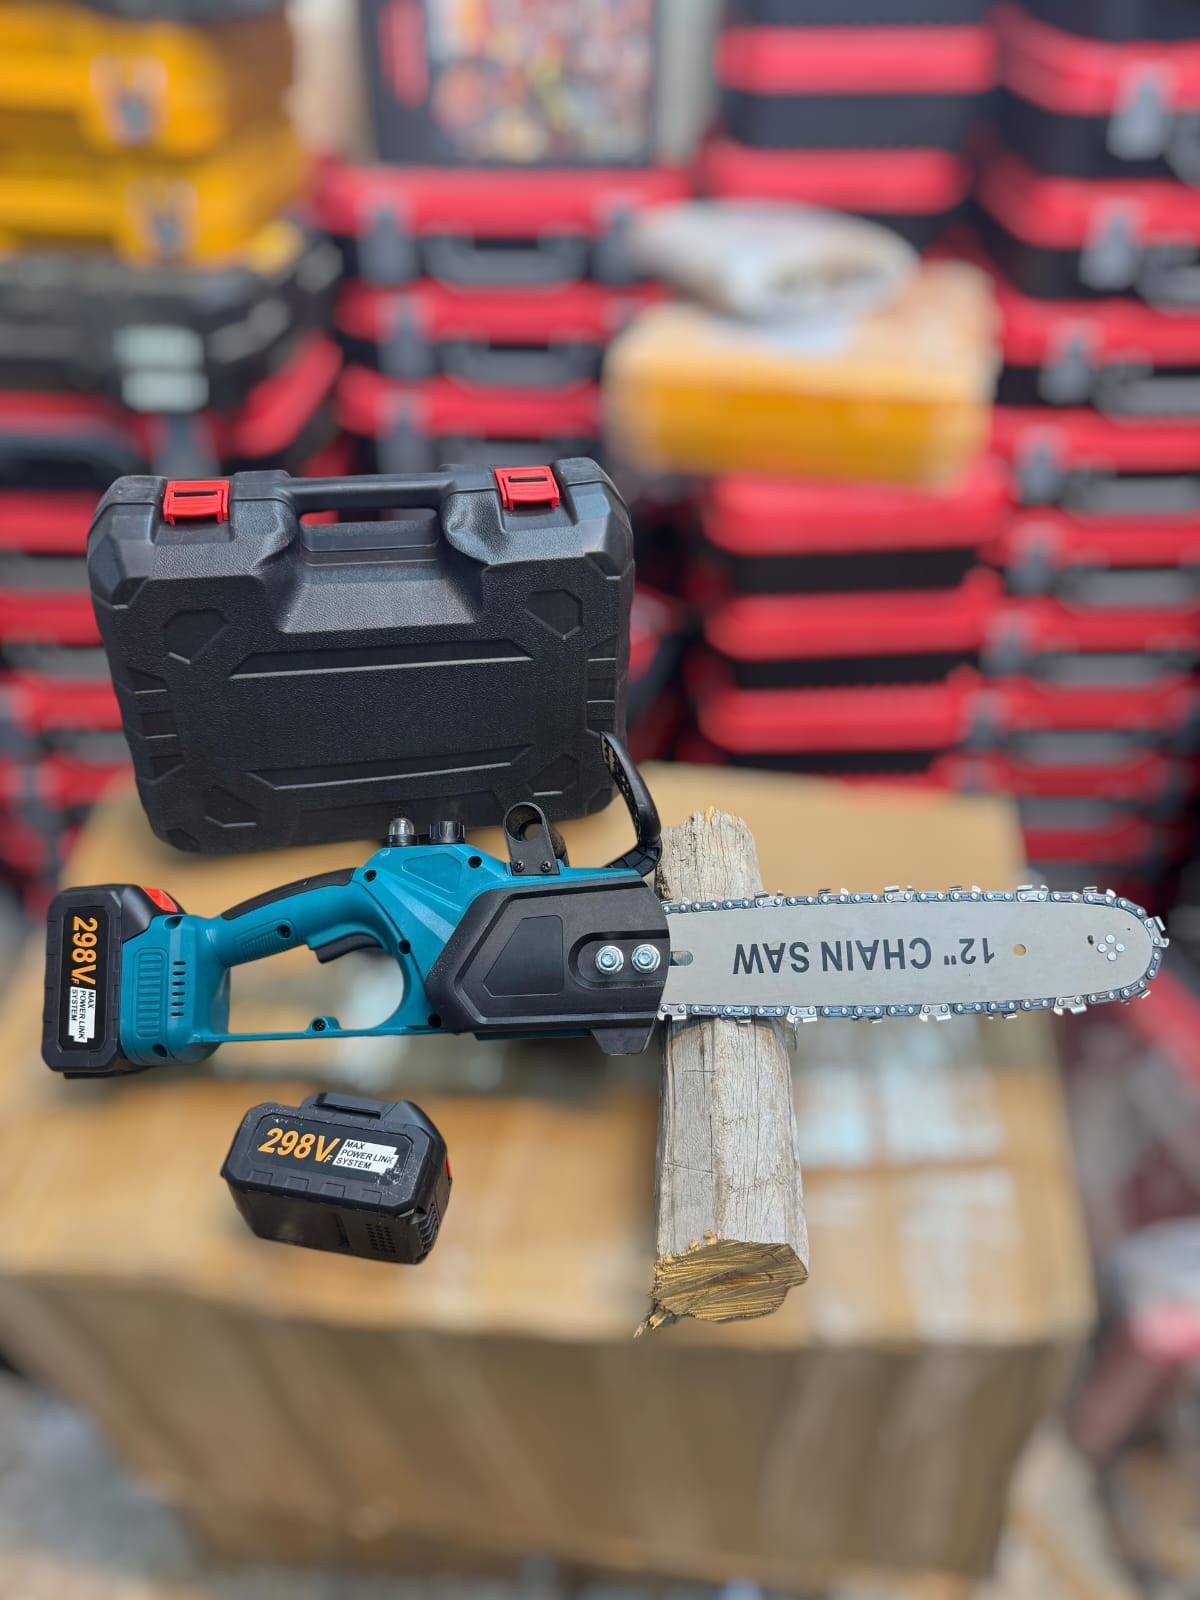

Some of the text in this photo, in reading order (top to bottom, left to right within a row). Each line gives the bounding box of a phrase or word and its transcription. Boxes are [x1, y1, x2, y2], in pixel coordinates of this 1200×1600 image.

[732, 937, 995, 975] 12" CHAIN SAW
[87, 991, 95, 1009] MAX
[78, 990, 87, 1040] POWER LINK
[345, 1141, 366, 1150] MAX
[335, 1157, 372, 1169] SYSTEM
[340, 1149, 395, 1164] POWER LINK
